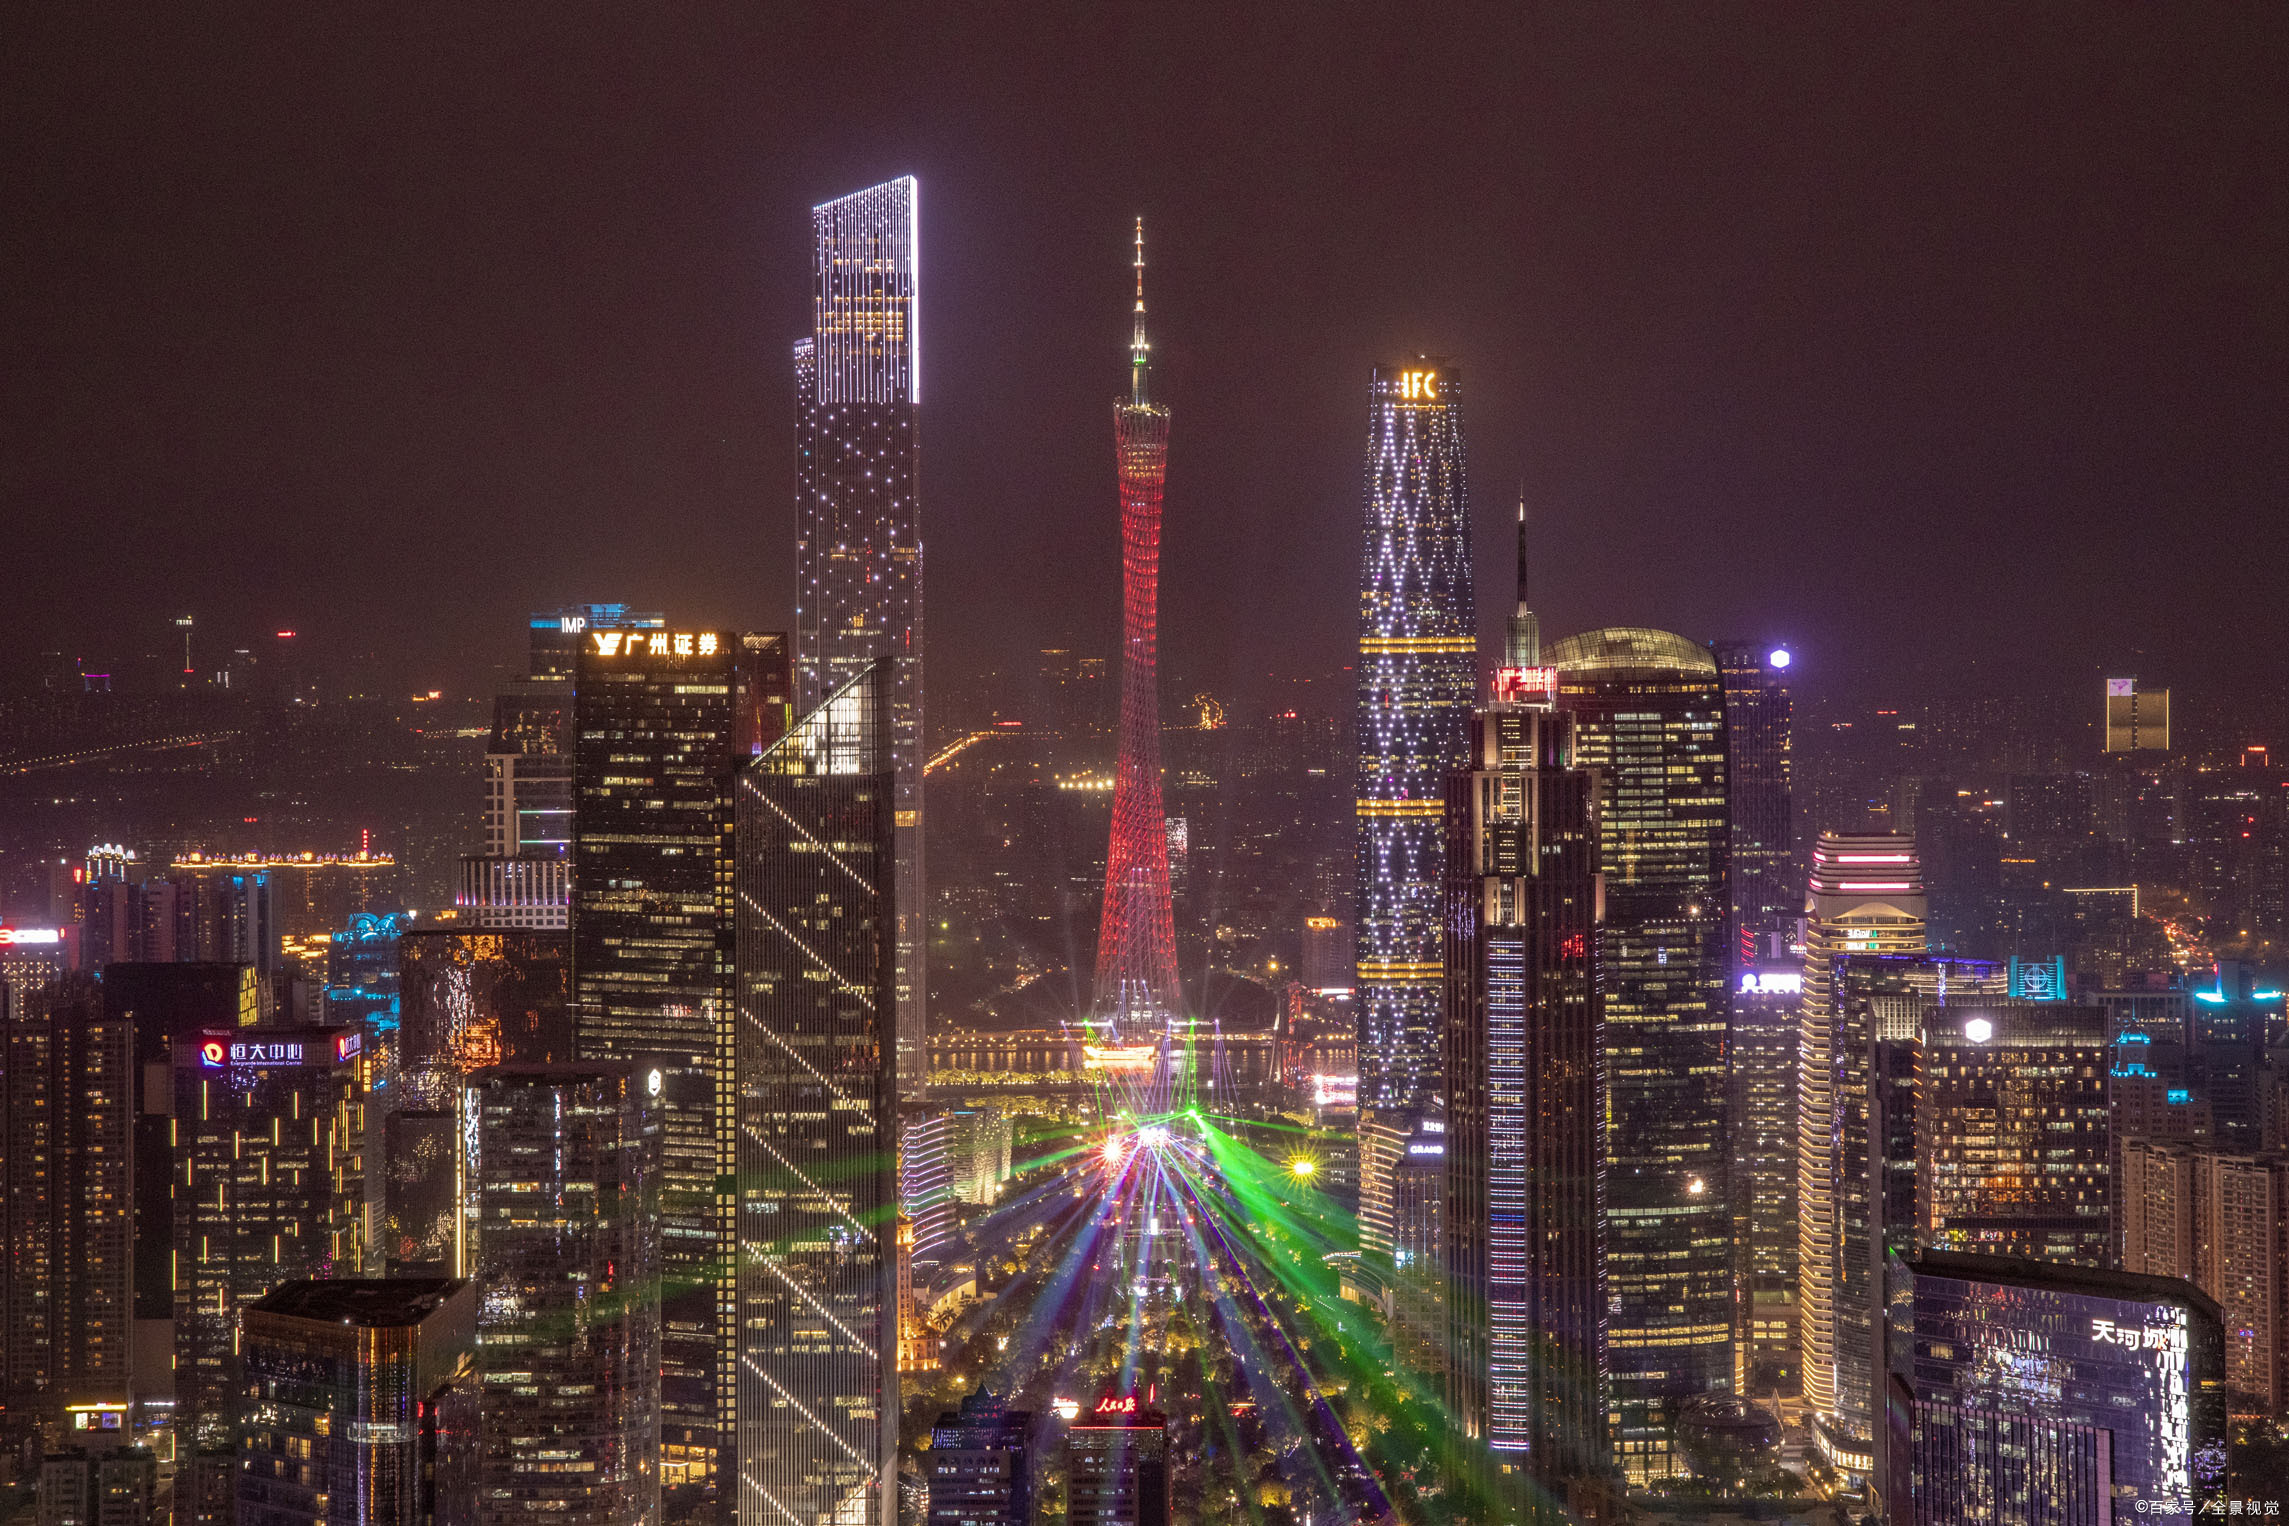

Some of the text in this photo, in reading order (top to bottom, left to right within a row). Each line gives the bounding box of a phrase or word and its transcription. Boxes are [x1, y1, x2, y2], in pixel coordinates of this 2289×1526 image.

[1402, 371, 1435, 399] IFC
[561, 617, 585, 633] IMP
[625, 633, 718, 655] 广州证券
[230, 1043, 303, 1060] 恒大中心
[1410, 1145, 1444, 1155] GRAND
[2092, 1319, 2169, 1351] 天河城
